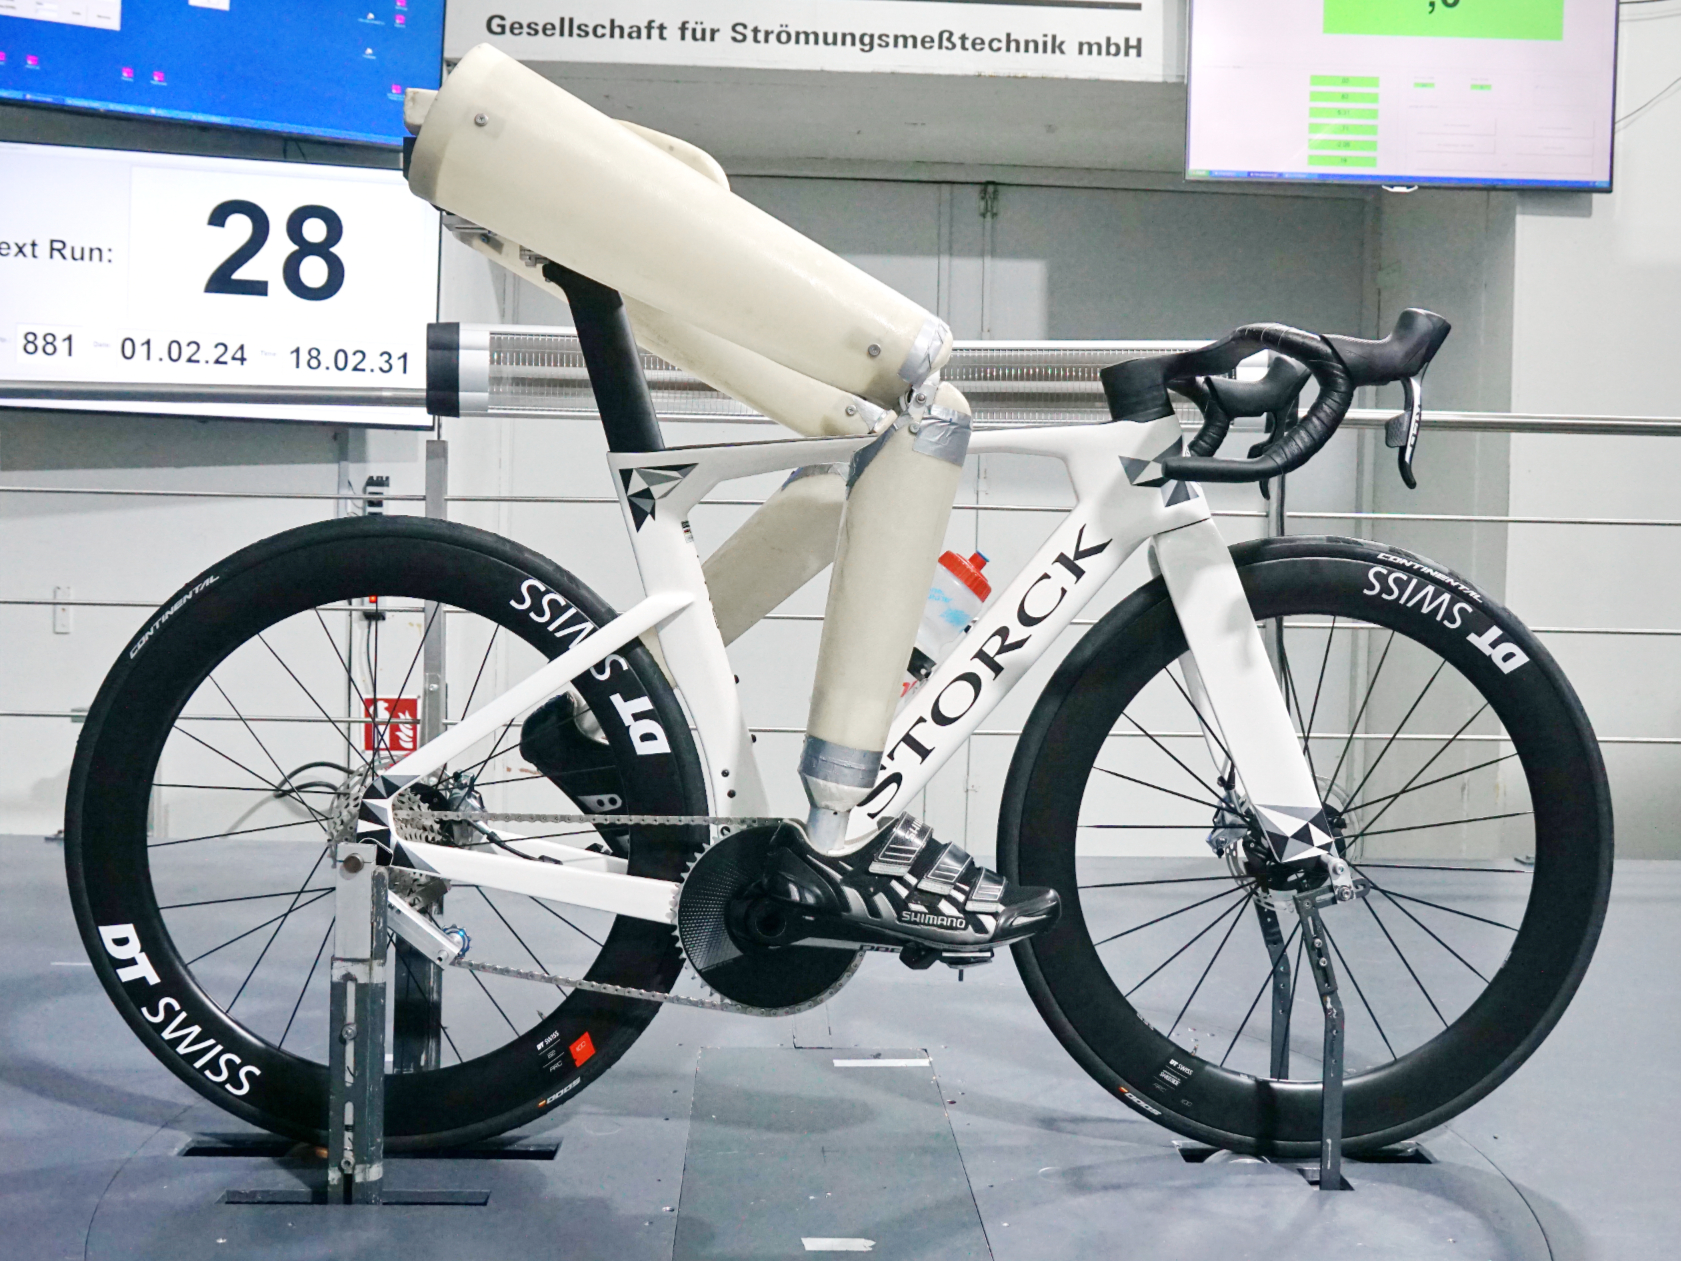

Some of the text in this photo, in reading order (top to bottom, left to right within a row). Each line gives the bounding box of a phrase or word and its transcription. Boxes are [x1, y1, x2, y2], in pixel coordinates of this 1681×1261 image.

[485, 14, 1143, 59] Gesellschaft für Strömungsmeßtechnik mbH
[49, 239, 113, 263] Run:
[203, 198, 346, 302] 28
[22, 331, 73, 357] 881
[120, 337, 248, 366] 01.02.24
[289, 346, 410, 375] 18.02.31
[1376, 552, 1483, 604] CONTINENTAL
[129, 574, 220, 660] CONTINENTAL
[1363, 566, 1531, 675] DT SWISS
[856, 523, 1113, 820] STORCK
[609, 692, 672, 756] DT
[901, 910, 966, 929] SHIMANO
[98, 922, 262, 1097] DT SWISS
